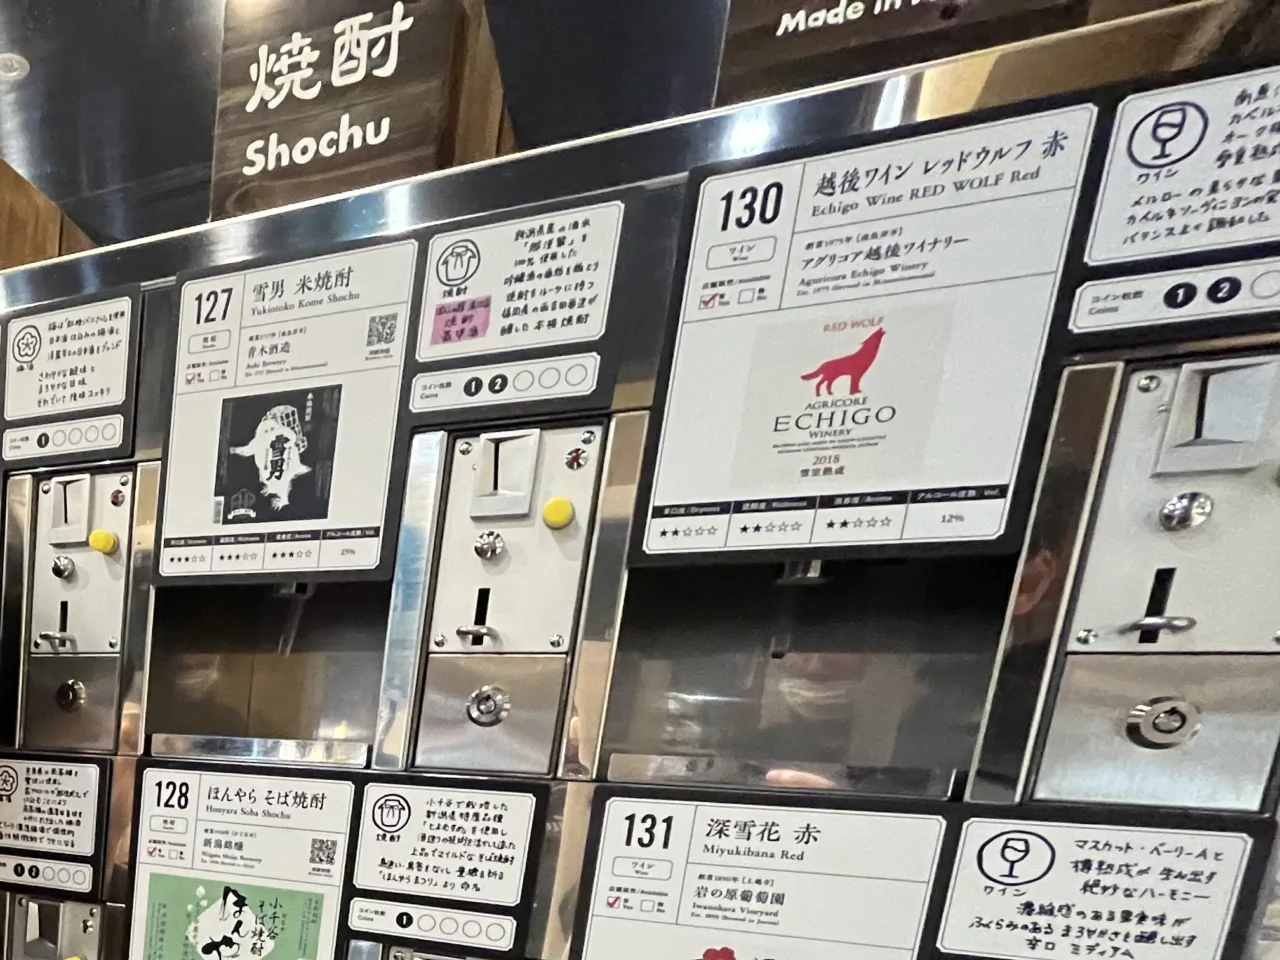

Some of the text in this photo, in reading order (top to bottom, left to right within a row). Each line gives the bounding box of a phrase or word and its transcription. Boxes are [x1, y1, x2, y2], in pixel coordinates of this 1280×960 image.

[775, 0, 865, 36] Made
[245, 1, 414, 112] 焼酎
[242, 113, 390, 176] Shochu
[814, 130, 1069, 197] 越後ワイン レッドウルフ 赤
[1137, 169, 1180, 184] ワイン
[811, 166, 1042, 218] Echigo Wine RED WOLF Red
[719, 181, 784, 233] 130
[800, 236, 970, 271] アグリコア越後ワイナリー
[252, 266, 355, 303] 雪男 米焼酎
[194, 287, 234, 325] 127
[298, 297, 325, 309] Kome
[327, 290, 361, 305] Shochu
[823, 317, 884, 333] RED WOLF
[247, 341, 292, 359] 青木酒造
[805, 396, 869, 411] AGRICORE
[773, 405, 897, 433] ECHIGO
[808, 427, 853, 439] WINERY
[155, 780, 190, 810] 128
[207, 786, 327, 811] ほんやら そば焼酎
[206, 805, 291, 820] Honyara Soba Shochu
[376, 833, 401, 843] 焼酎
[623, 813, 674, 850] 131
[705, 817, 821, 845] 深雪花 赤
[702, 843, 805, 861] Miyukibana Red
[693, 885, 785, 906] 岩の原葡萄園
[983, 885, 1027, 897] ワイン
[250, 897, 284, 958] 小千谷 そば焼酎
[1070, 943, 1135, 959] ミディアム
